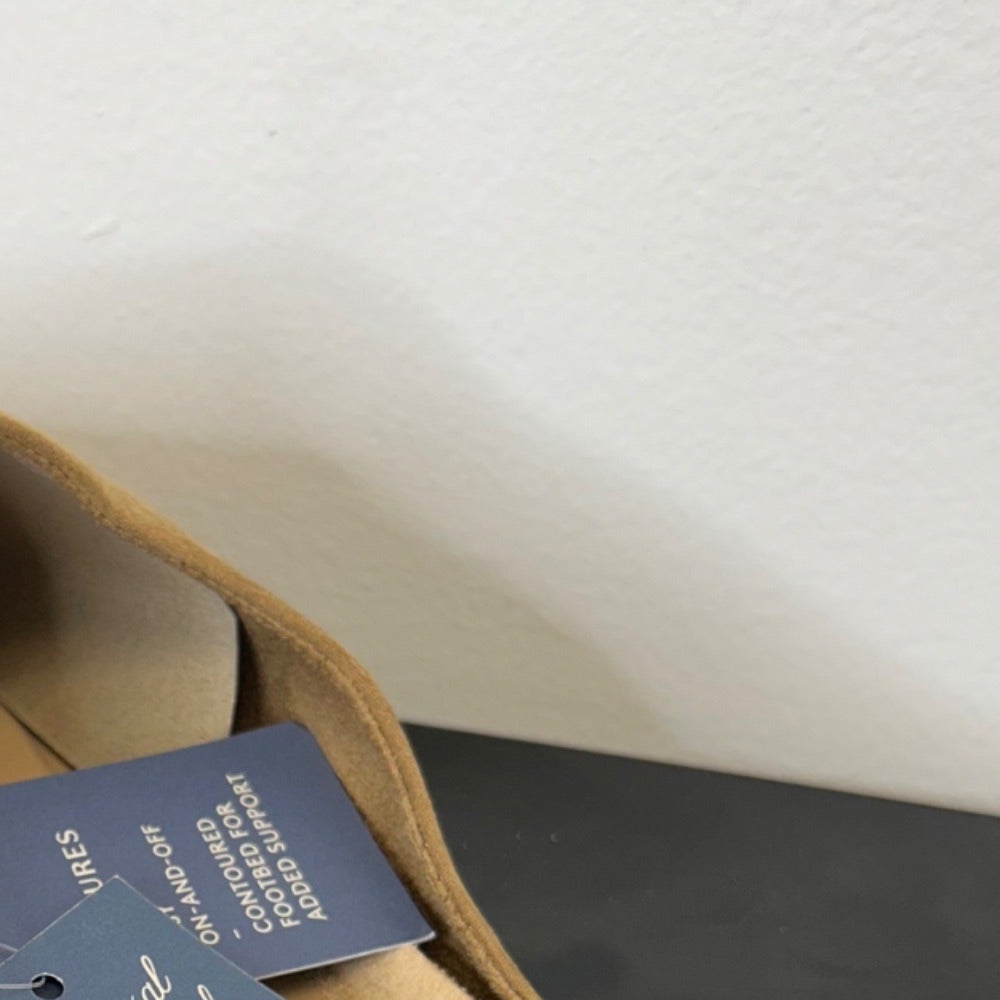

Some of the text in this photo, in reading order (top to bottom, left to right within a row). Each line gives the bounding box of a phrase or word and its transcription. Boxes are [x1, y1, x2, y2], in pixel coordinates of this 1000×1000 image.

[55, 828, 103, 895] URES
[140, 824, 219, 945] ON-AND-OFF
[196, 818, 273, 934] CONTOURED
[216, 801, 301, 928] FOOTBED FOR
[225, 773, 327, 921] ADDED SUPPORT
